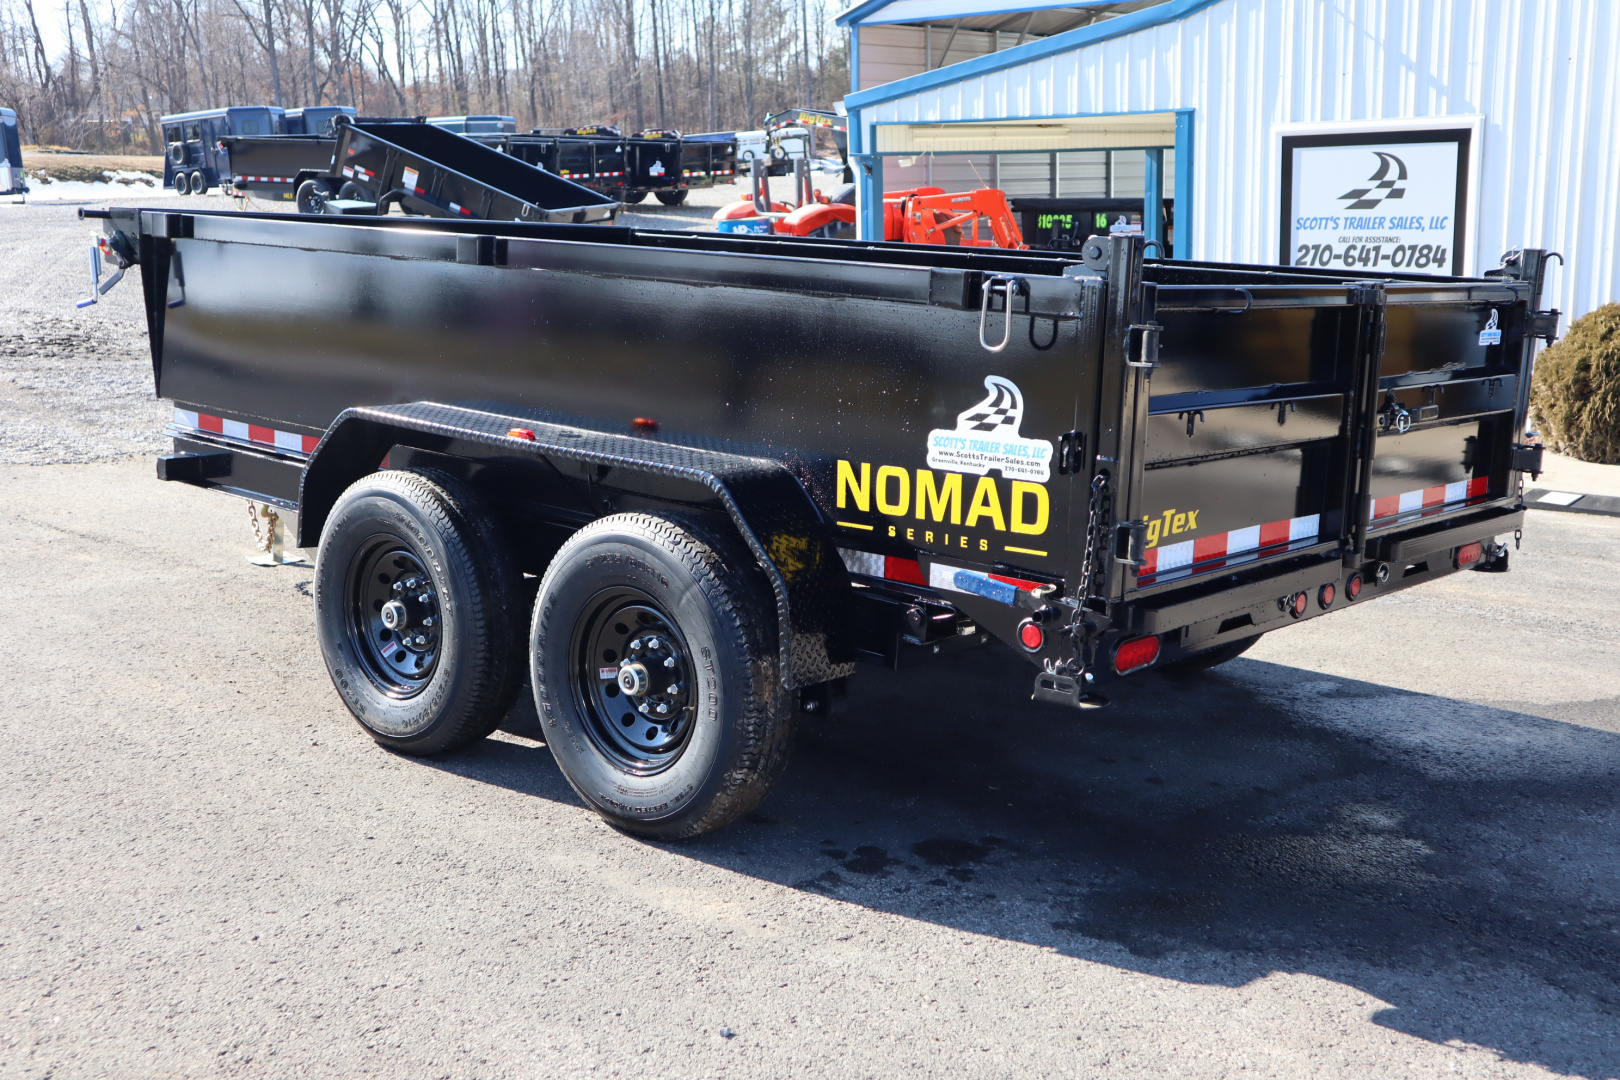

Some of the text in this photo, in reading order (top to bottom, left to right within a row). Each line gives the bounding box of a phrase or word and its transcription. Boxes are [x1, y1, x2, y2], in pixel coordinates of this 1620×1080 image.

[798, 112, 834, 126] BigTex
[1295, 216, 1449, 232] SCOTT'S TRAILER SALES, LLC
[1295, 244, 1447, 268] 270-641-0784
[933, 436, 1048, 459] SCOTT'S TRAILER SALES, LLC
[938, 451, 1041, 468] www.ScottsTrailerSales.com
[959, 460, 986, 469] Kentucky
[1004, 466, 1045, 476] 270-641-0784
[836, 459, 1050, 536] NOMAD
[887, 526, 989, 551] SERIES
